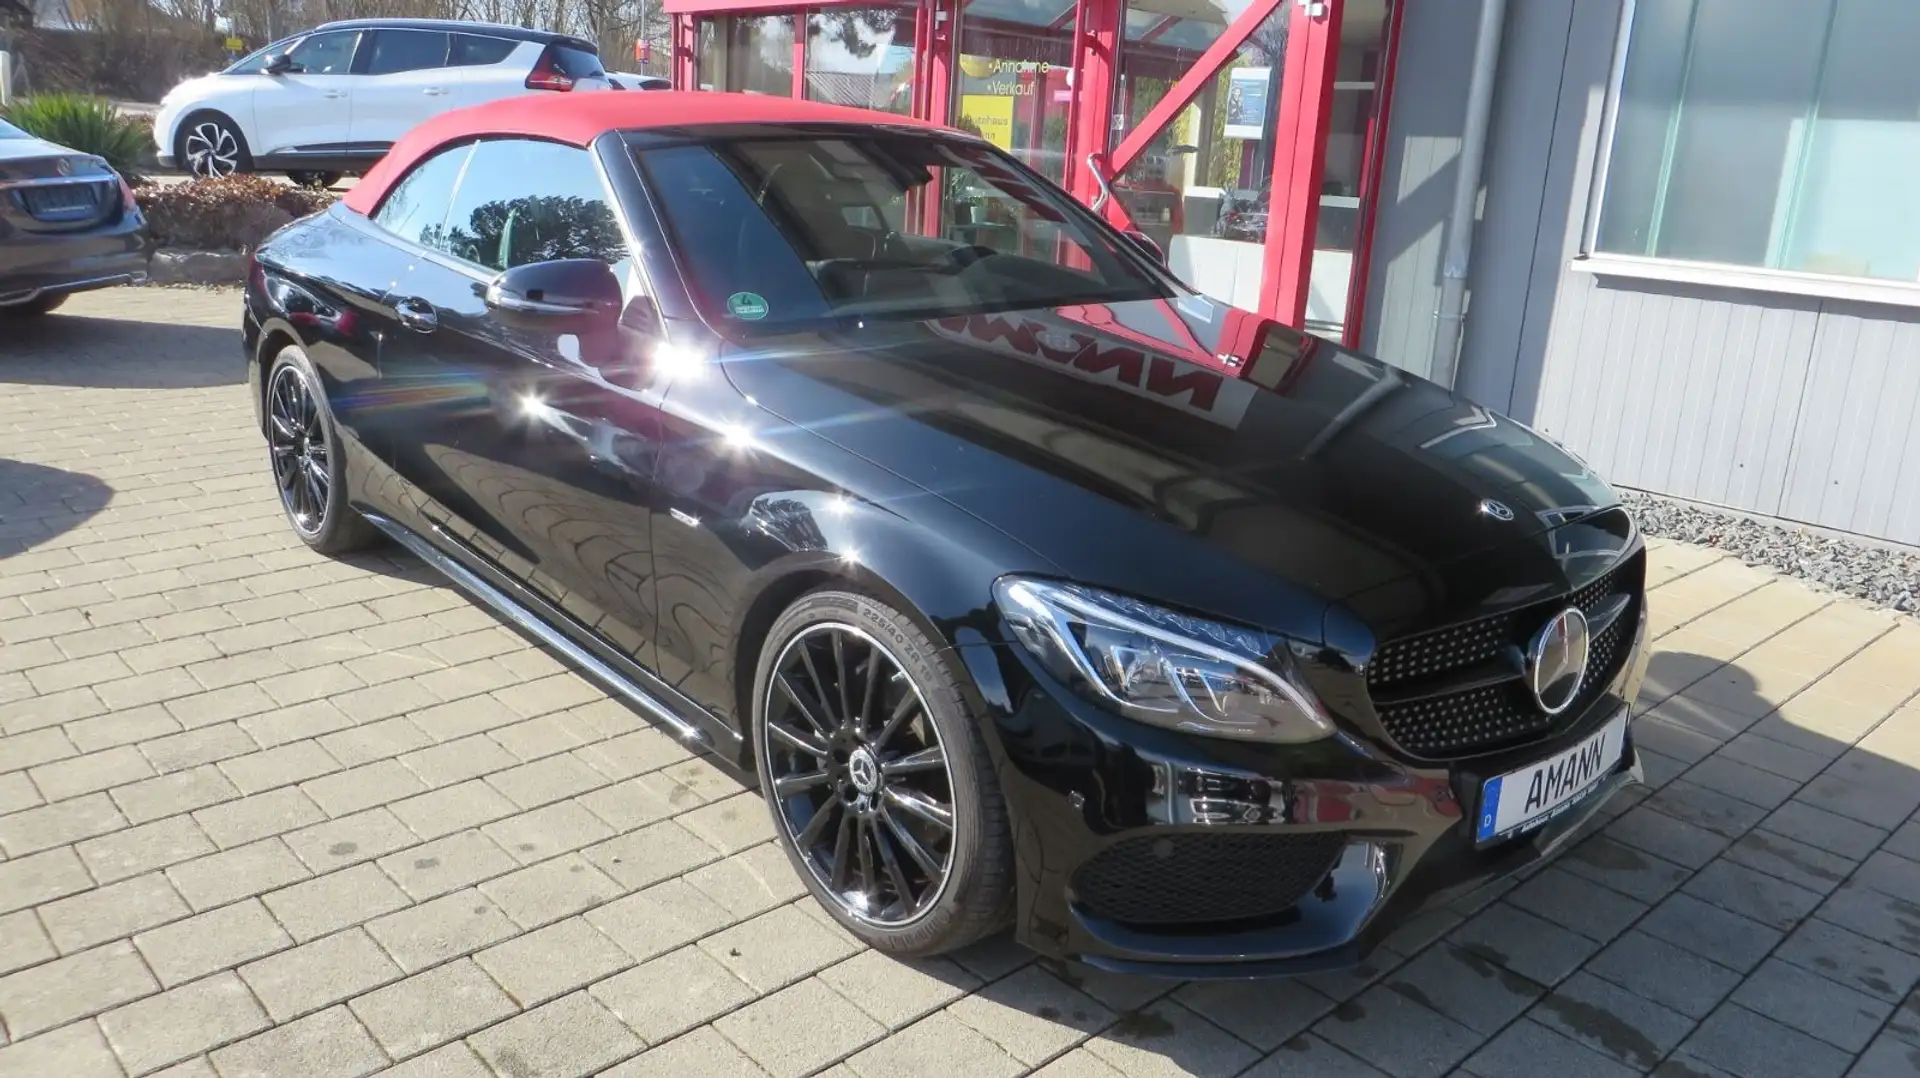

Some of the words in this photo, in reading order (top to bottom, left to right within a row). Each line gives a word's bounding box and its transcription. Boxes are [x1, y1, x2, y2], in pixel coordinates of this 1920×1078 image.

[992, 58, 1049, 74] Annahme
[992, 81, 1035, 95] Verkauf
[1484, 814, 1492, 828] D
[1524, 733, 1606, 814] AMANN
